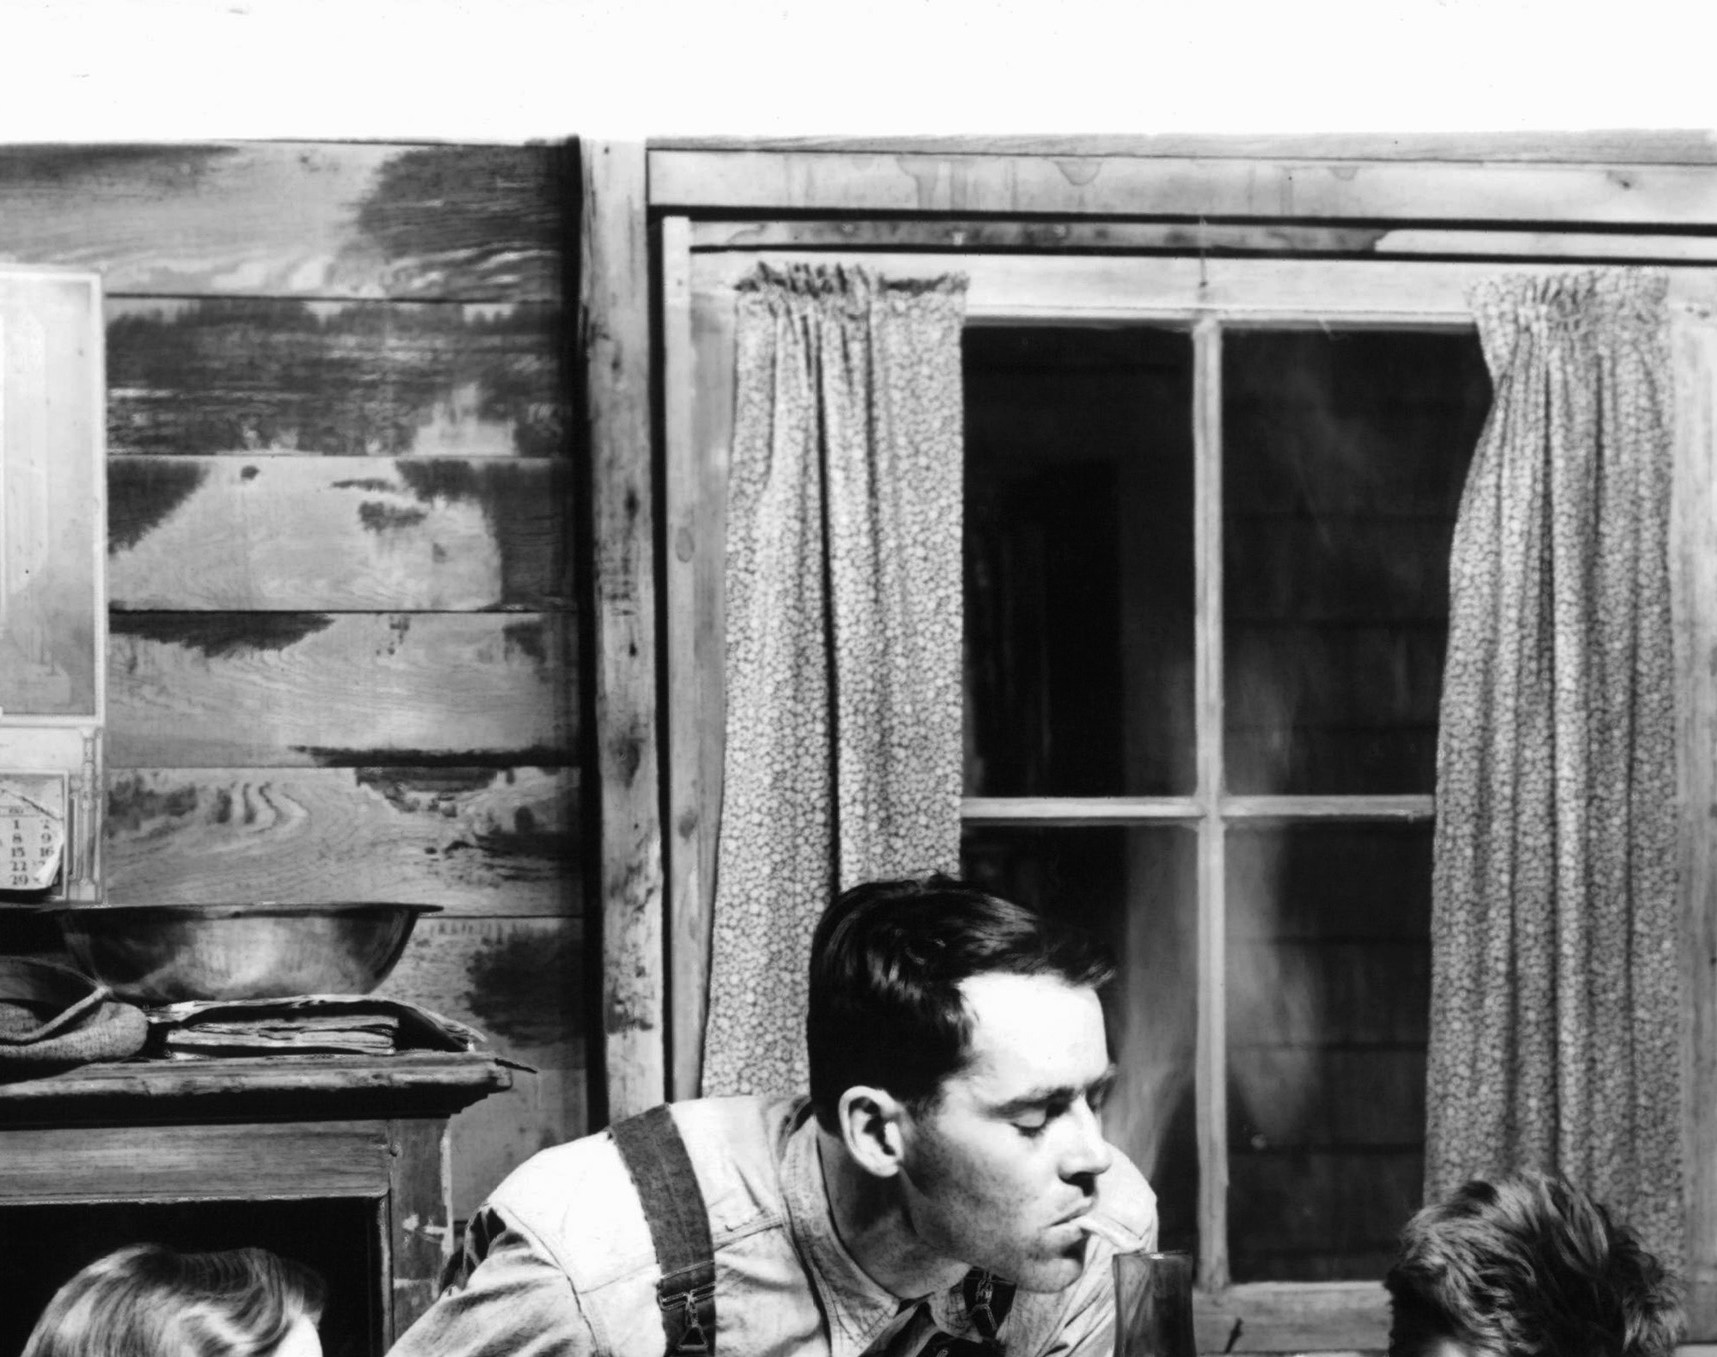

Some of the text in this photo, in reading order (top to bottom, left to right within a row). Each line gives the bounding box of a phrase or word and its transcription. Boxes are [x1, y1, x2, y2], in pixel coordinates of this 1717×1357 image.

[13, 819, 20, 831] 1
[12, 832, 22, 844] 8
[41, 832, 52, 844] 9
[11, 847, 25, 858] 15
[39, 847, 54, 858] 16
[10, 861, 27, 872] 22
